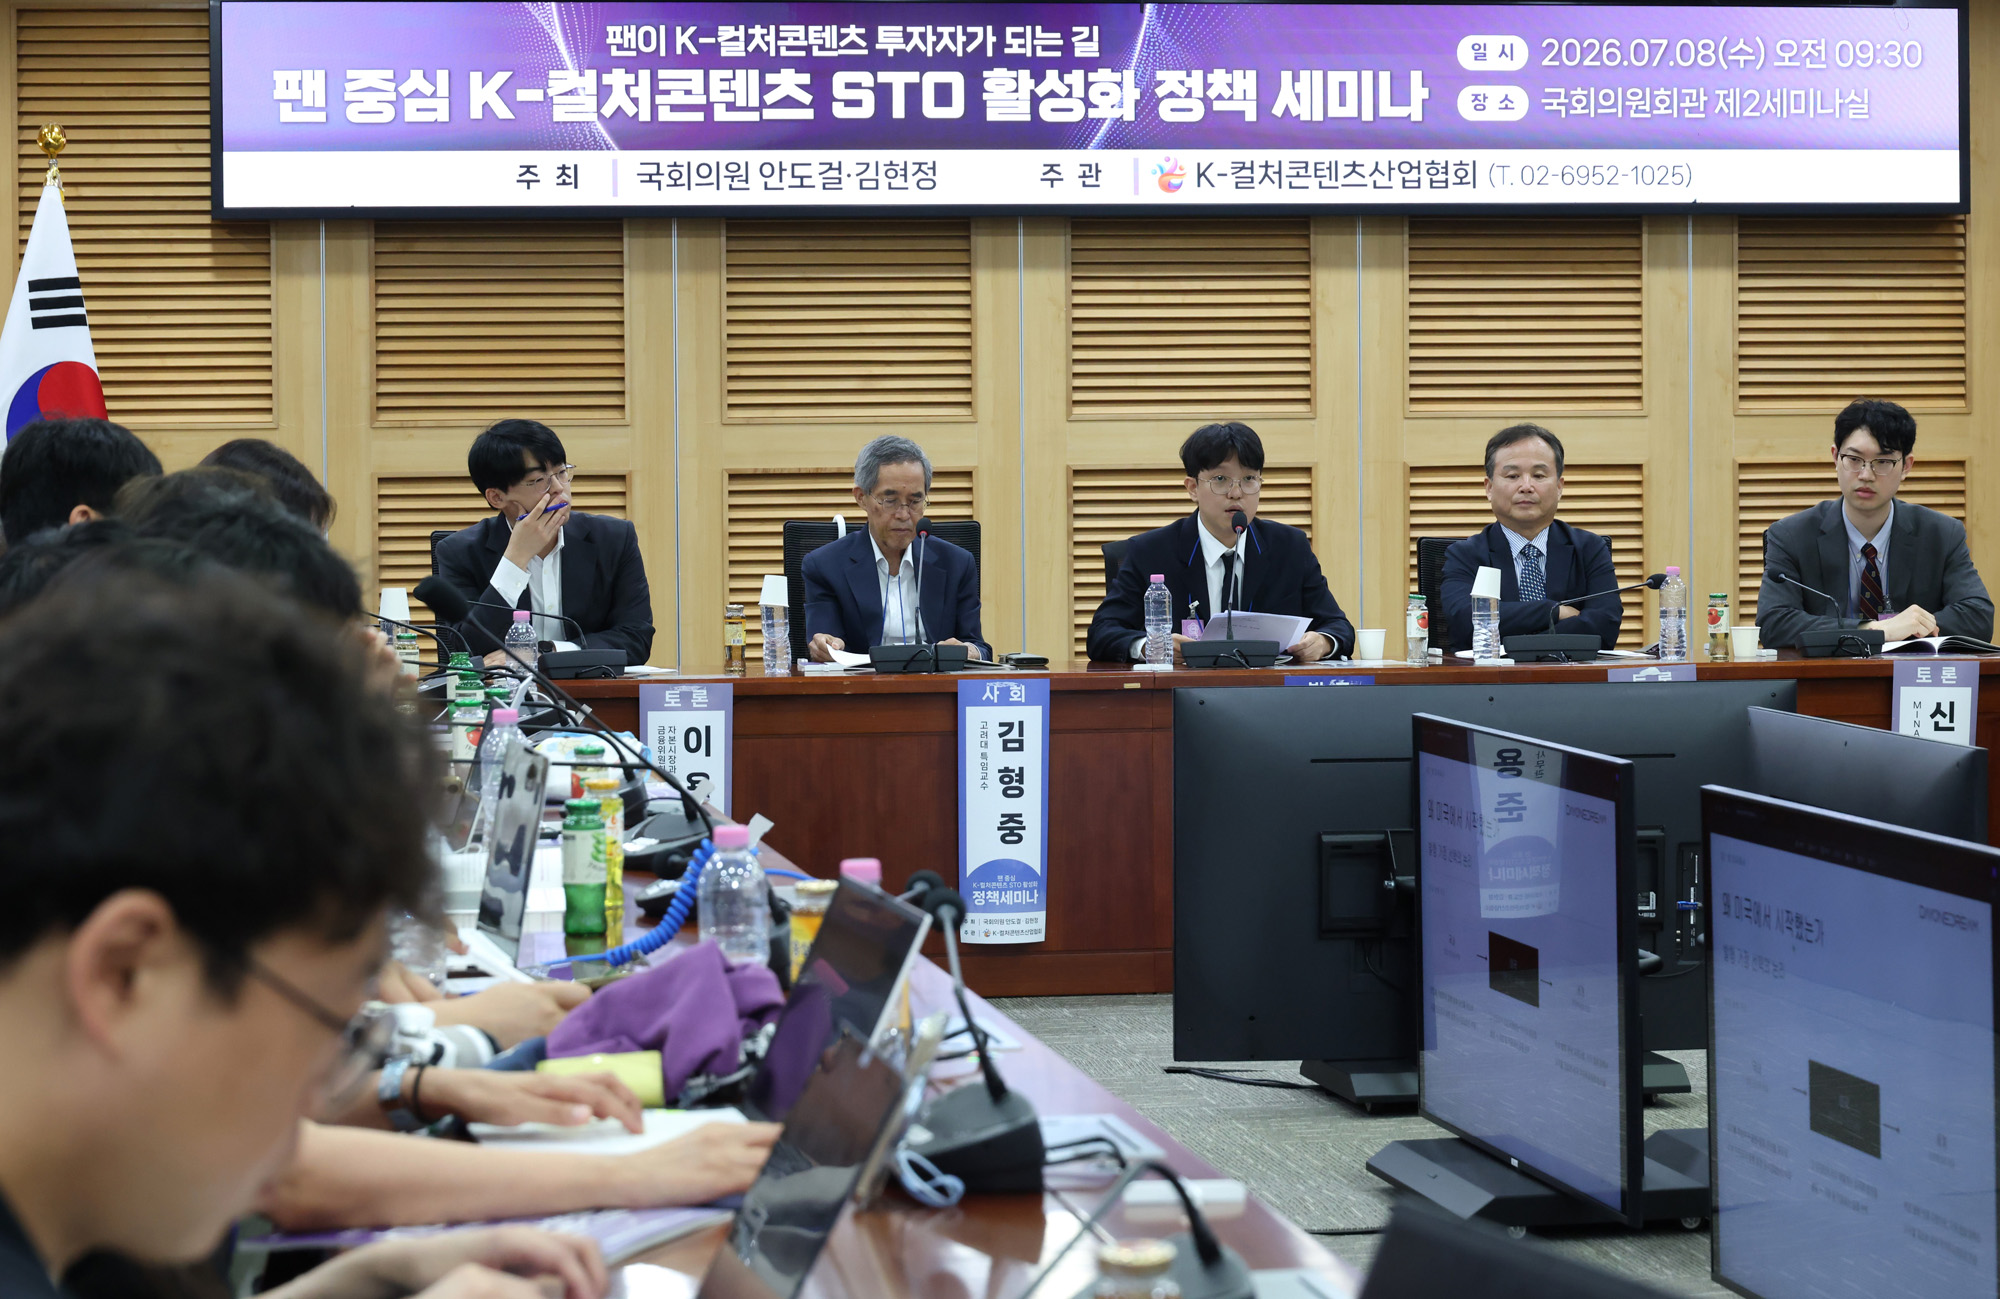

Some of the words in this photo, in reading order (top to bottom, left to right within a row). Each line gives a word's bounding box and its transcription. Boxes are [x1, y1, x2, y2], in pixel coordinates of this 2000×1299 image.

[606, 24, 665, 57] 팬이
[676, 24, 868, 57] K-컬처콘텐츠
[875, 24, 996, 57] 투자자가
[1003, 24, 1063, 57] 되는
[1071, 25, 1101, 58] 길
[1541, 37, 1765, 71] 2026.07.08(수)
[1773, 39, 1827, 69] 오전
[1835, 41, 1922, 68] 09:30
[272, 69, 327, 124] 팬
[344, 69, 450, 123] 중심
[469, 69, 814, 122] K-컬처콘텐츠
[832, 70, 965, 120] STO
[982, 68, 1140, 123] 활성화
[1155, 69, 1257, 123] 정책
[1271, 70, 1429, 123] 세미나
[1541, 87, 1707, 119] 국회의원회관
[1715, 87, 1870, 119] 제2세미나실
[637, 161, 750, 191] 국회의원
[1196, 160, 1477, 191] K-컬처콘텐츠산업협회
[1488, 163, 1514, 188] (T.
[1521, 163, 1693, 188] 02-6952-1025)
[1913, 701, 1922, 737] MINA
[1929, 701, 1955, 731] 신
[972, 889, 1039, 906] 정책세미나
